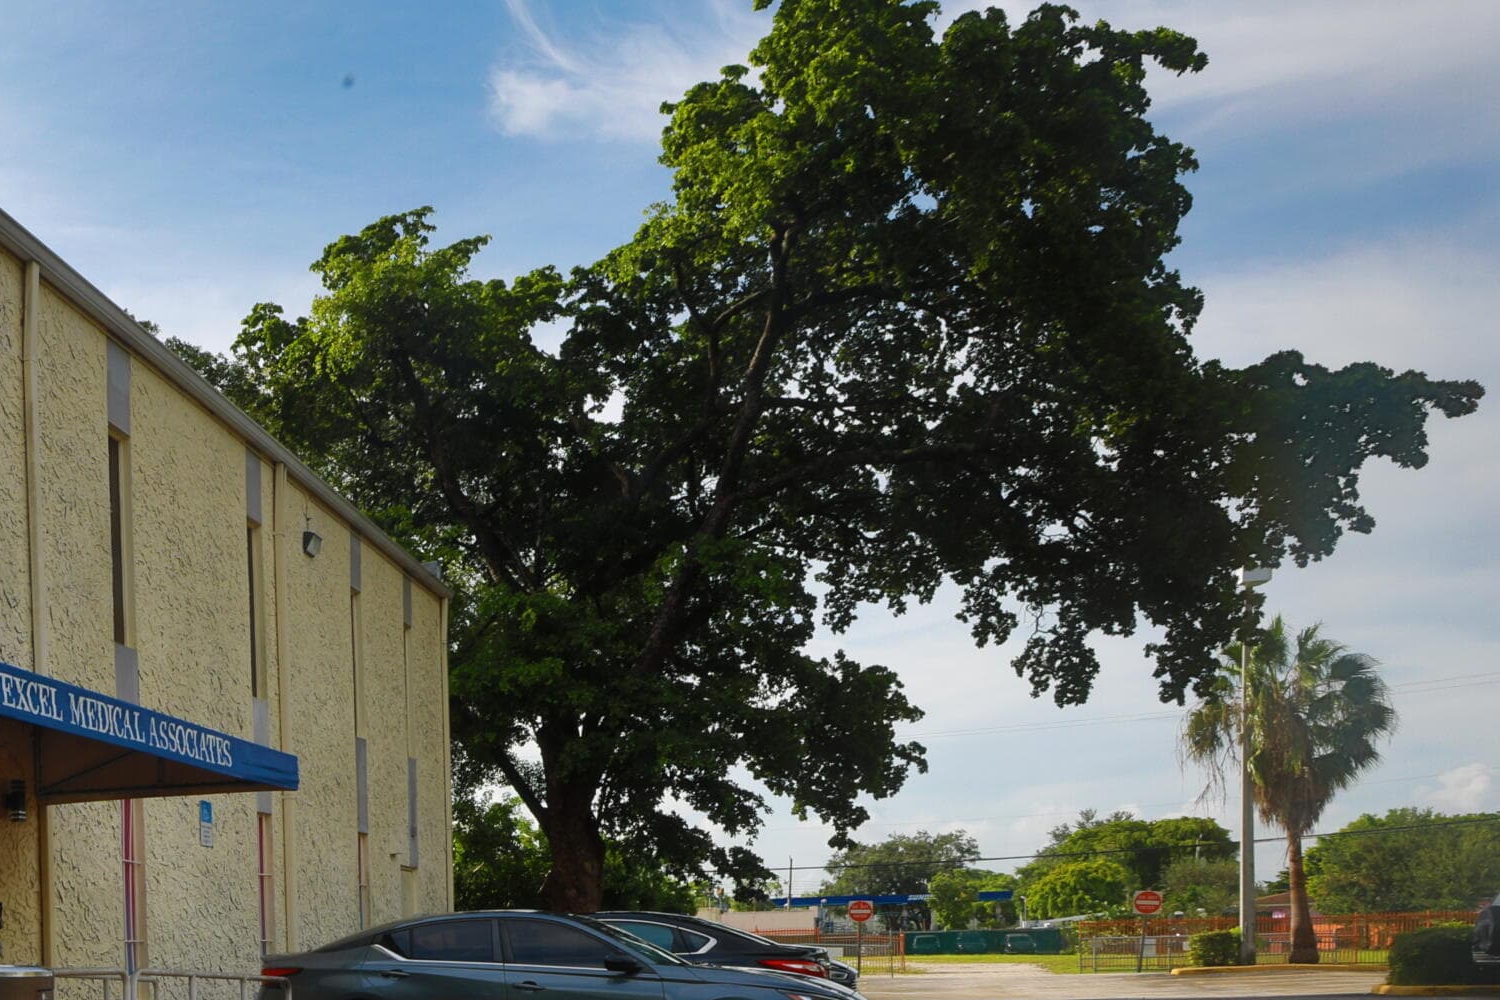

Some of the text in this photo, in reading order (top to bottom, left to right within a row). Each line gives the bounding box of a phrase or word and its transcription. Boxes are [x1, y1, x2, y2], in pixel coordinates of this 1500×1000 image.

[0, 672, 233, 768] EXCEL MEDICAL ASSOCIATES
